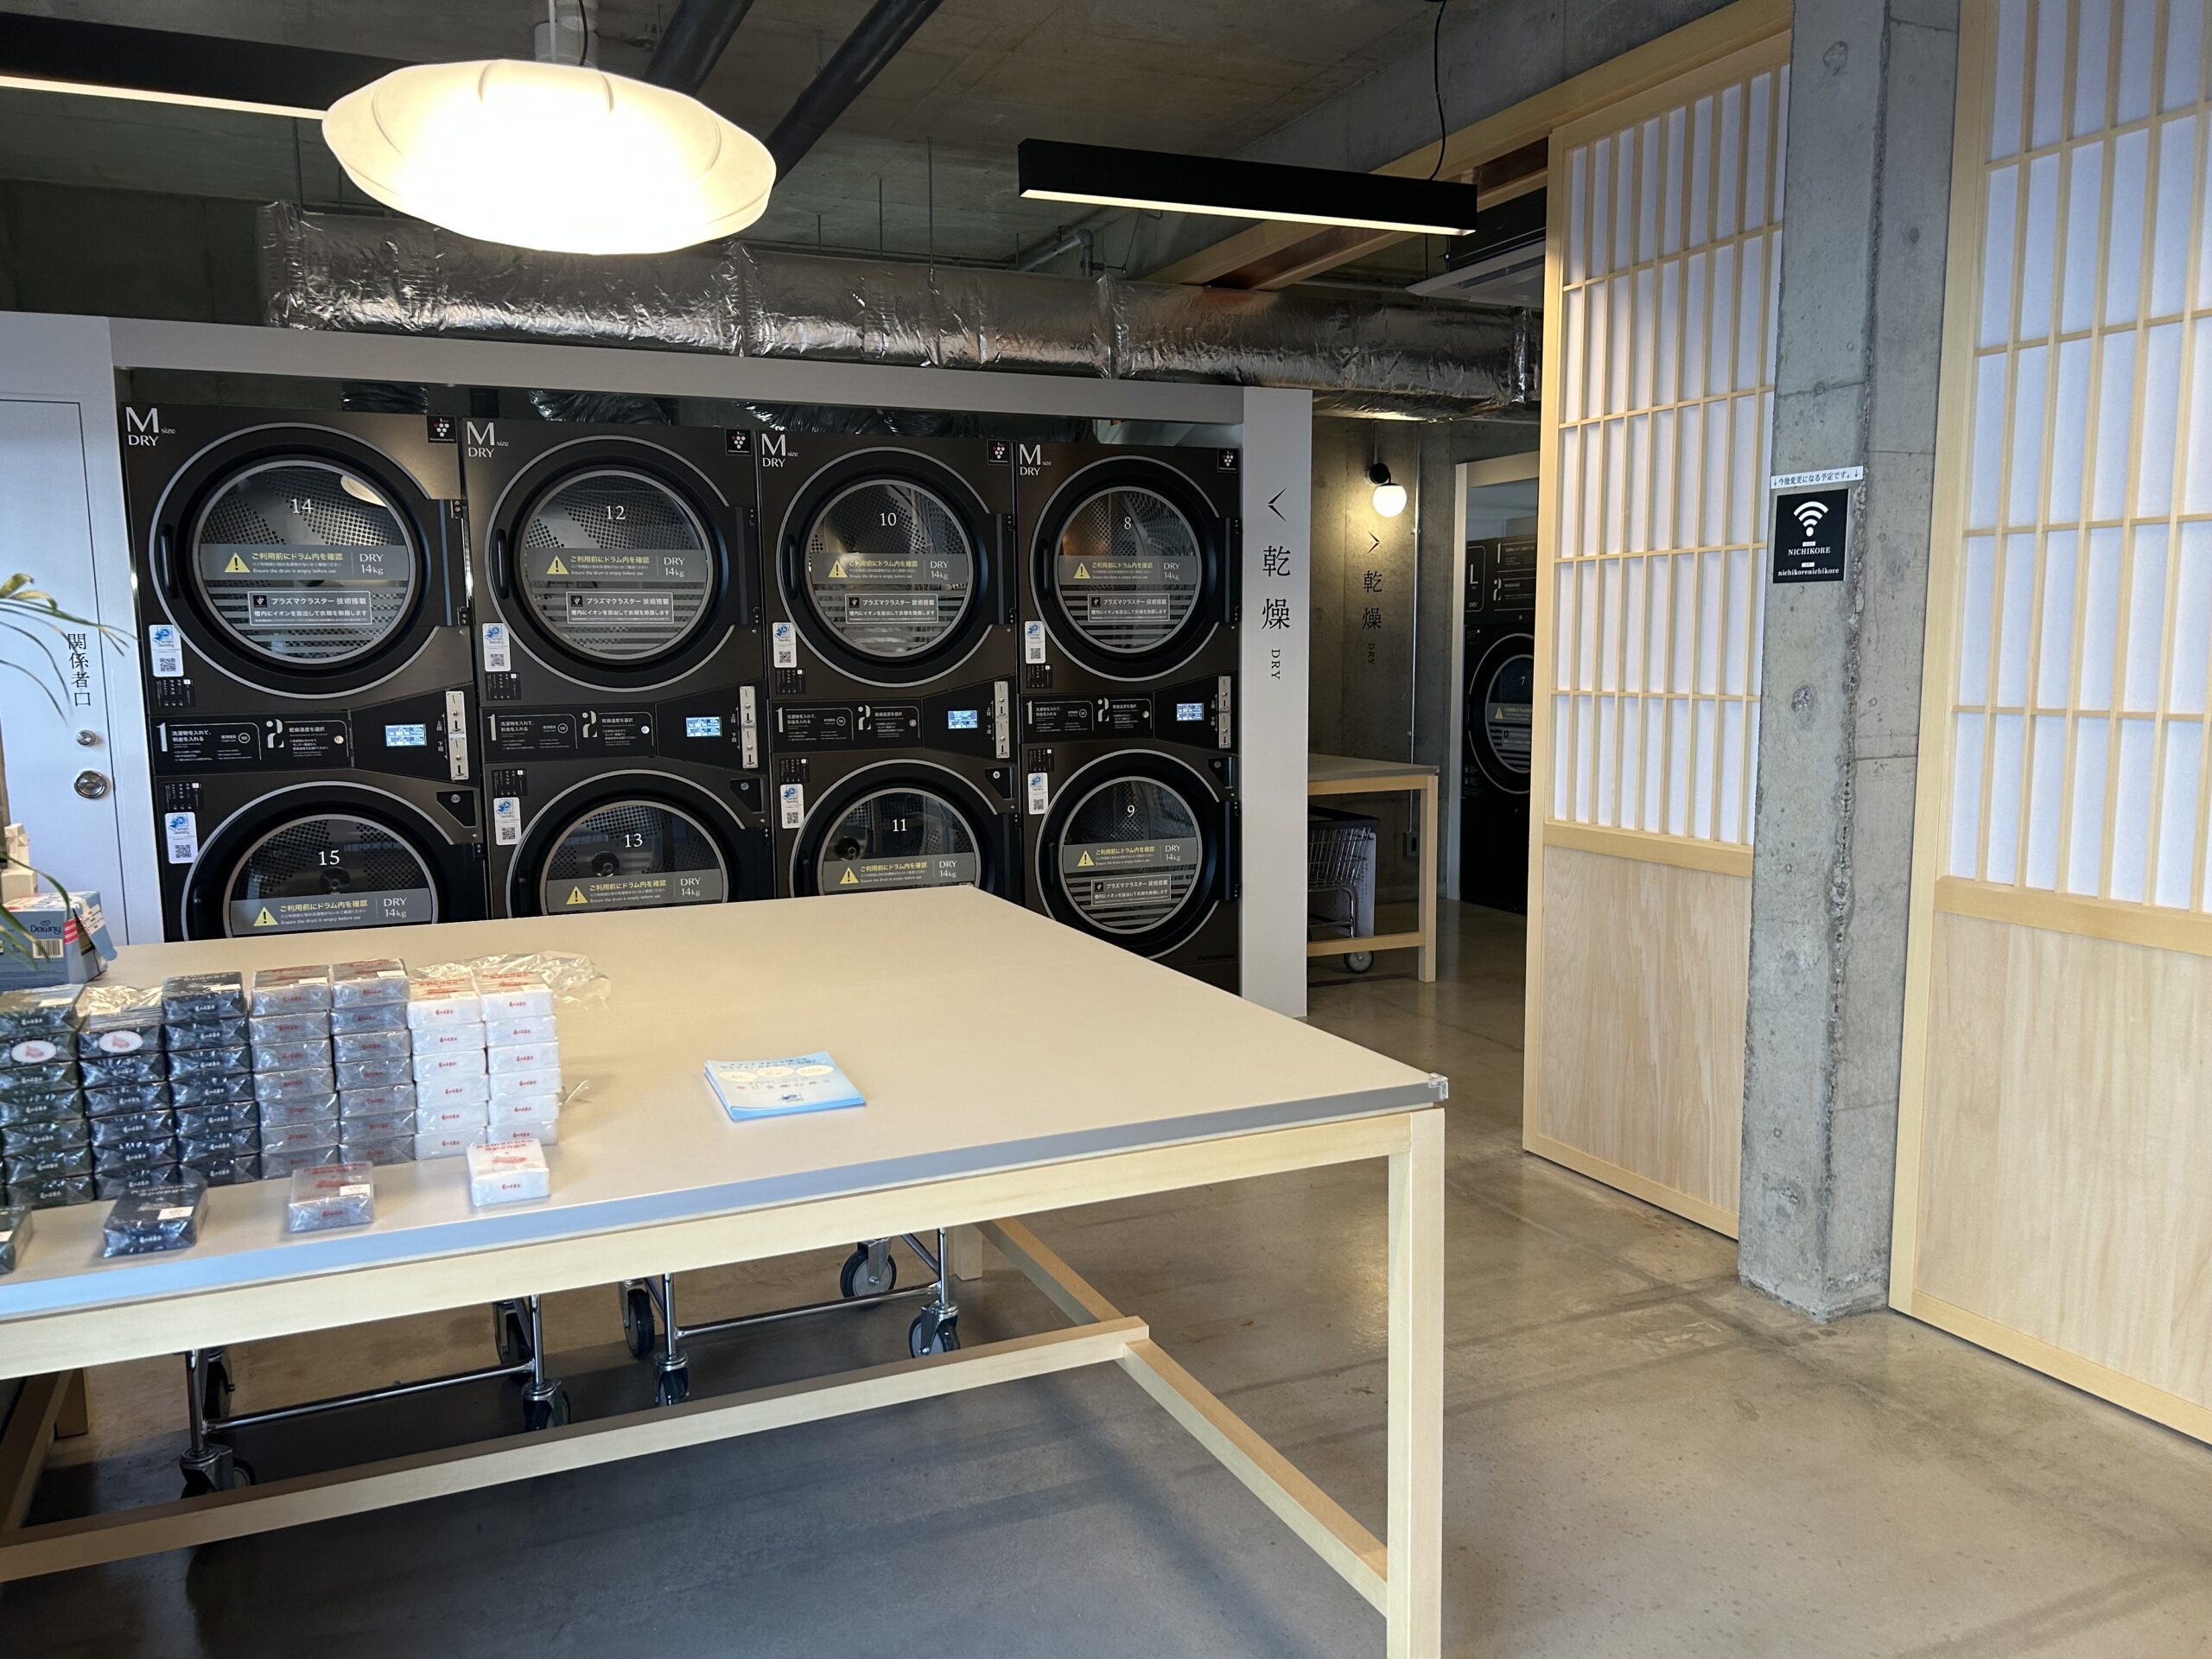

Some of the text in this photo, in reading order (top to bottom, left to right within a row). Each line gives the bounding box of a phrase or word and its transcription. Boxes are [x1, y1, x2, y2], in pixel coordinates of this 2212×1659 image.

[125, 407, 159, 433] M
[128, 435, 159, 446] DRY
[467, 421, 495, 446] M
[761, 434, 786, 456] M
[468, 448, 494, 458] DRY
[1020, 443, 1041, 466] M
[762, 458, 785, 467] DRY
[1020, 467, 1040, 476] DRY
[290, 499, 314, 515] 14
[606, 505, 626, 520] 12
[880, 512, 897, 526] 10
[1123, 517, 1132, 530] 8
[251, 552, 344, 561] ご利用前にドラム内を確認
[359, 553, 384, 562] DRY
[1788, 547, 1831, 556] NICHIKORE
[664, 556, 684, 565] DRY
[360, 565, 384, 575] 14kg
[665, 568, 684, 577] 14kg
[931, 570, 949, 580] 14kg
[1164, 571, 1179, 581] 14kg
[1470, 563, 1478, 584] L
[1777, 568, 1840, 576] nichikorenichikore
[1262, 545, 1291, 630] 乾燥
[1363, 570, 1382, 630] 乾燥
[67, 633, 91, 707] 関係者口
[1271, 649, 1281, 680] DRY
[1026, 700, 1033, 724] 1
[1097, 697, 1109, 722] 2
[582, 710, 598, 738] 2
[776, 707, 783, 733] 1
[858, 704, 872, 730] 2
[266, 719, 284, 748] 2
[487, 714, 497, 741] 1
[156, 722, 168, 752] 1
[1127, 804, 1135, 817] 9
[892, 818, 907, 832] 11
[624, 834, 643, 848] 13
[318, 850, 340, 866] 15
[939, 860, 957, 868] DRY
[680, 878, 701, 887] DRY
[682, 887, 701, 897] 14kg
[280, 899, 368, 912] ご利用前にドラム内を確認
[384, 897, 407, 907] DRY
[385, 909, 407, 918] 14kg
[30, 925, 61, 935] Downy
